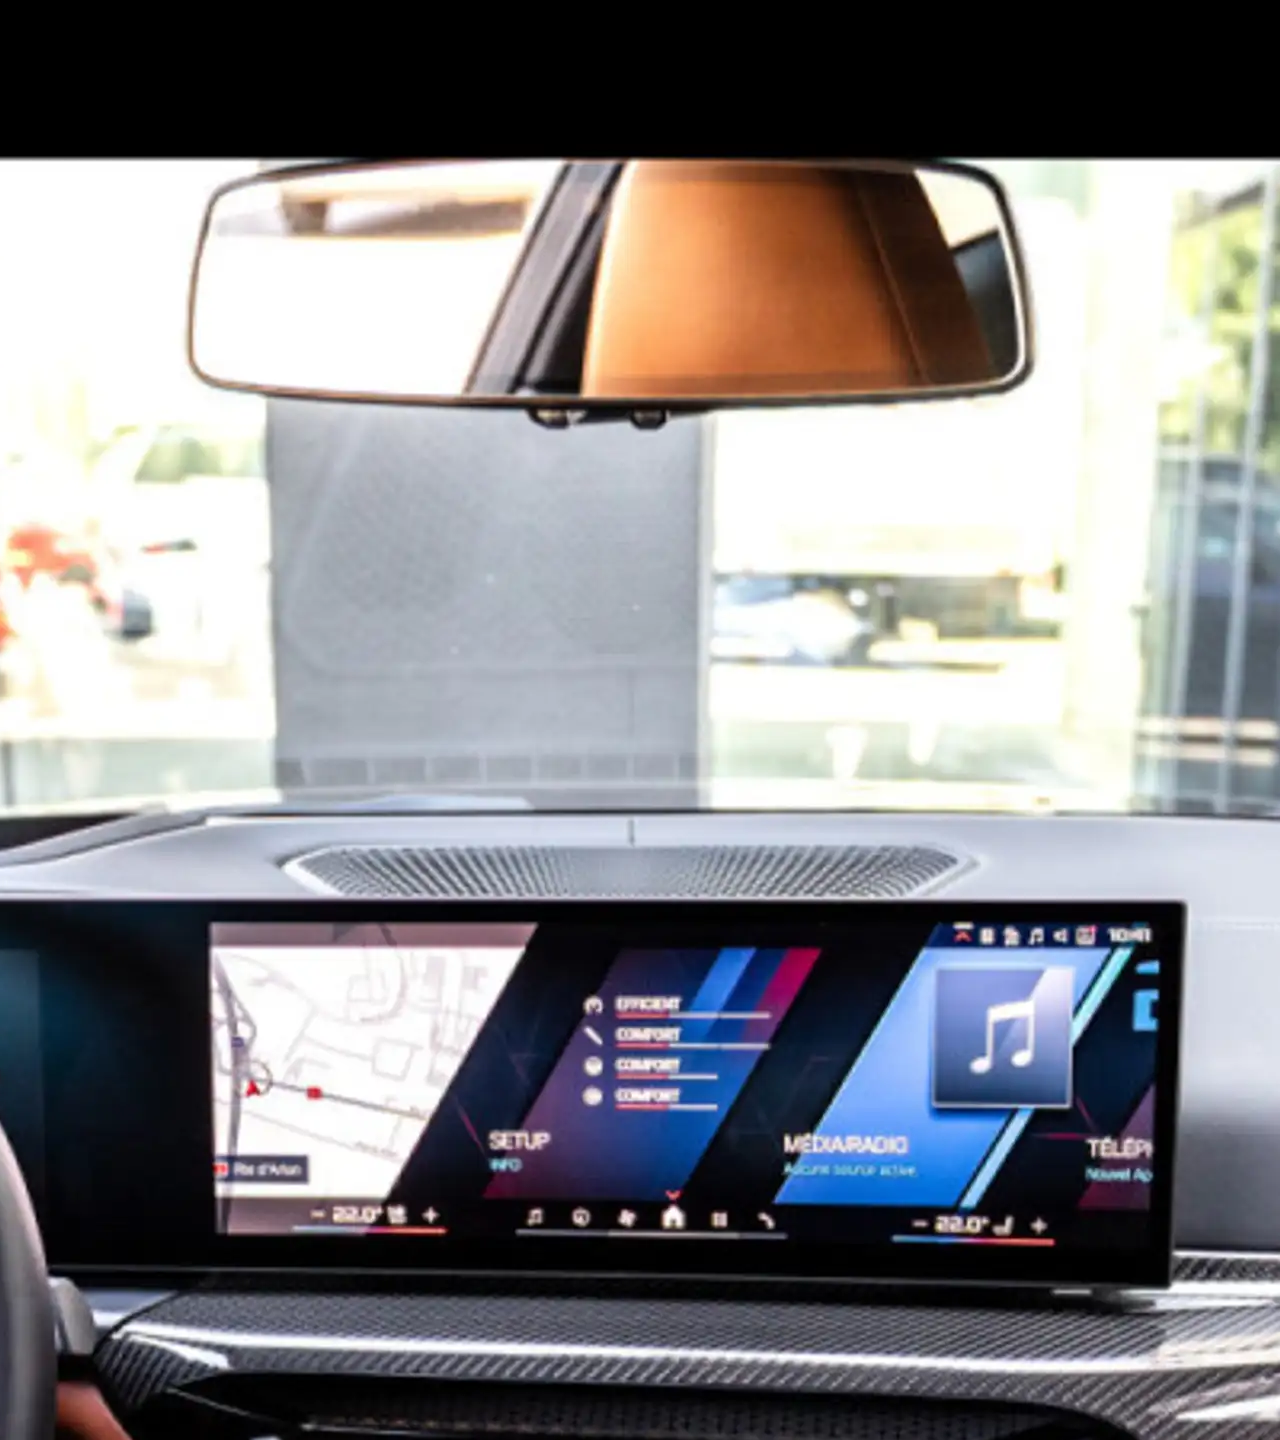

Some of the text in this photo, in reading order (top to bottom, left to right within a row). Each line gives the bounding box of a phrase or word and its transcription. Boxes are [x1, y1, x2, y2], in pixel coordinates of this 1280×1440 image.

[615, 1027, 681, 1042] COMFORT
[615, 1058, 681, 1072] COMFORT
[614, 1088, 680, 1102] COMFORT
[489, 1130, 550, 1150] SETUP
[489, 1158, 523, 1172] INFO
